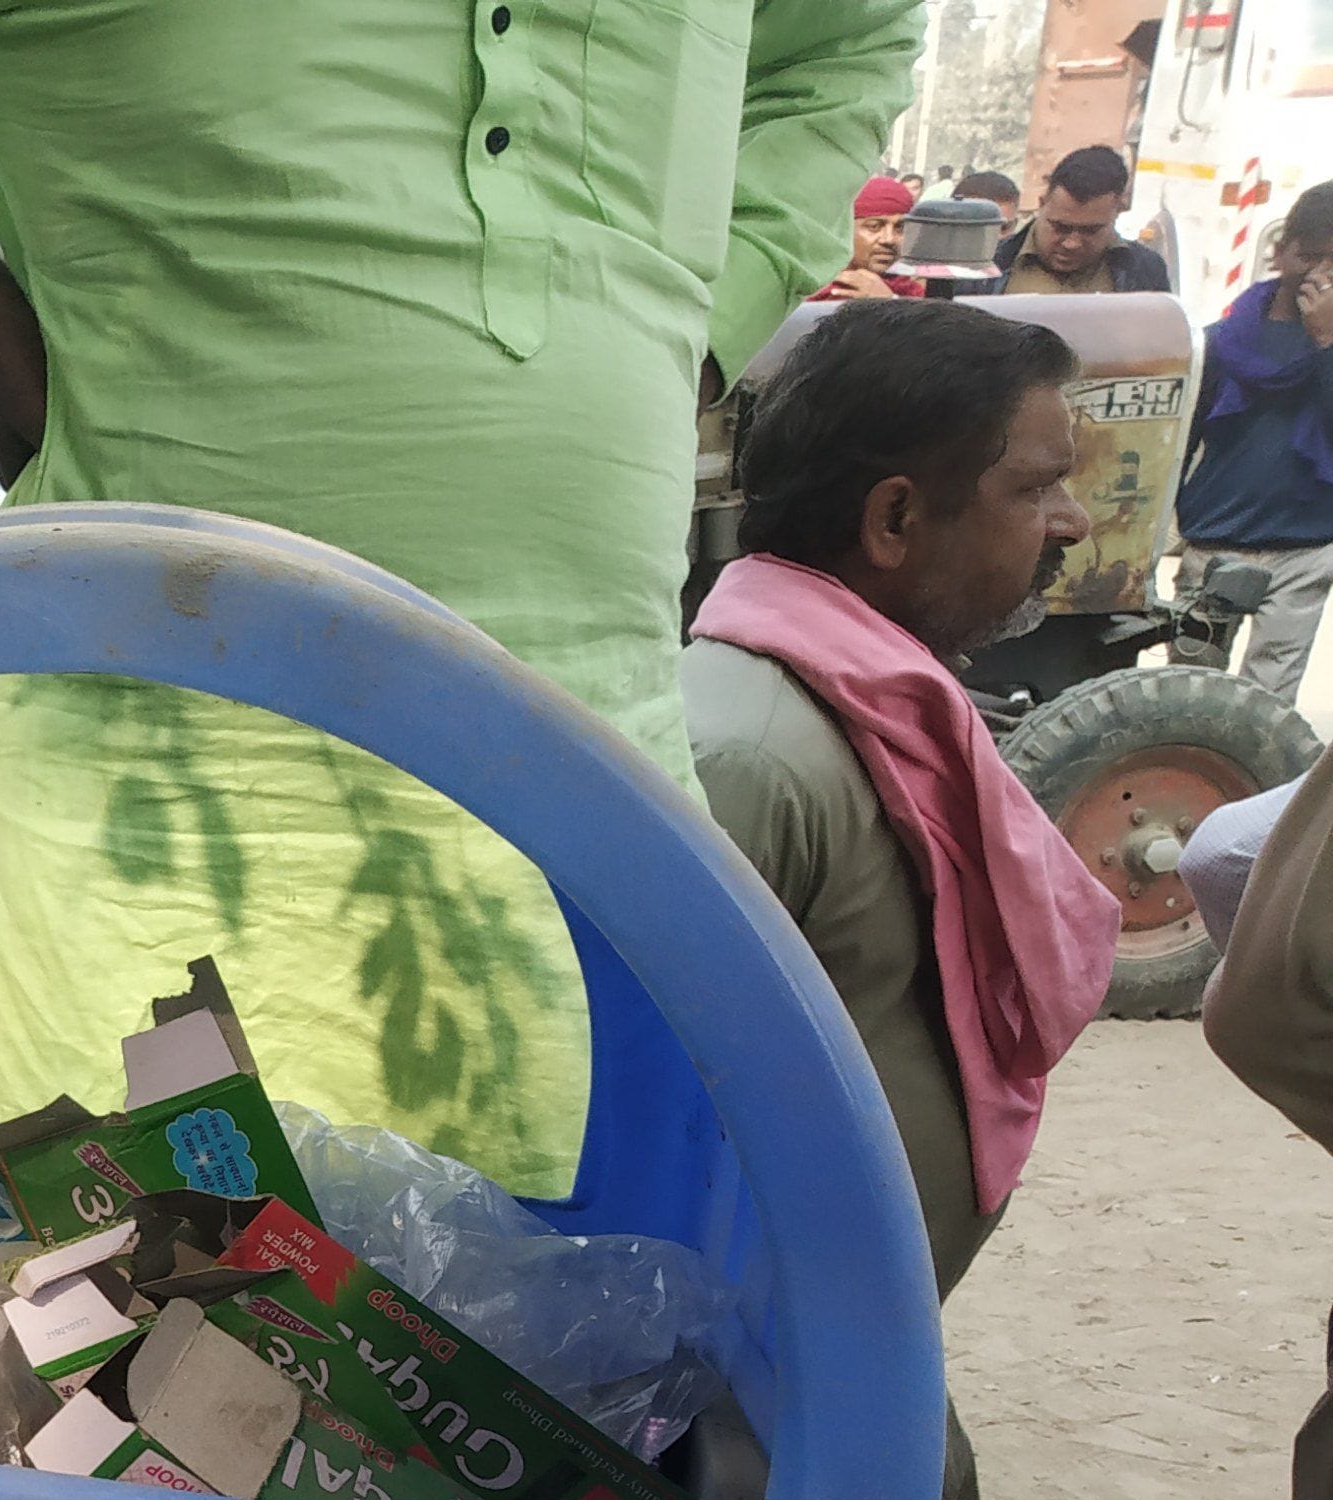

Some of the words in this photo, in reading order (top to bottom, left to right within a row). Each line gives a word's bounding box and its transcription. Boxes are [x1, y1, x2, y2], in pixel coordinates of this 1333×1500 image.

[262, 1229, 321, 1275] POWDER
[290, 1228, 317, 1251] MIX
[367, 1289, 461, 1365] Dhoop
[502, 1390, 553, 1439] Dhoop
